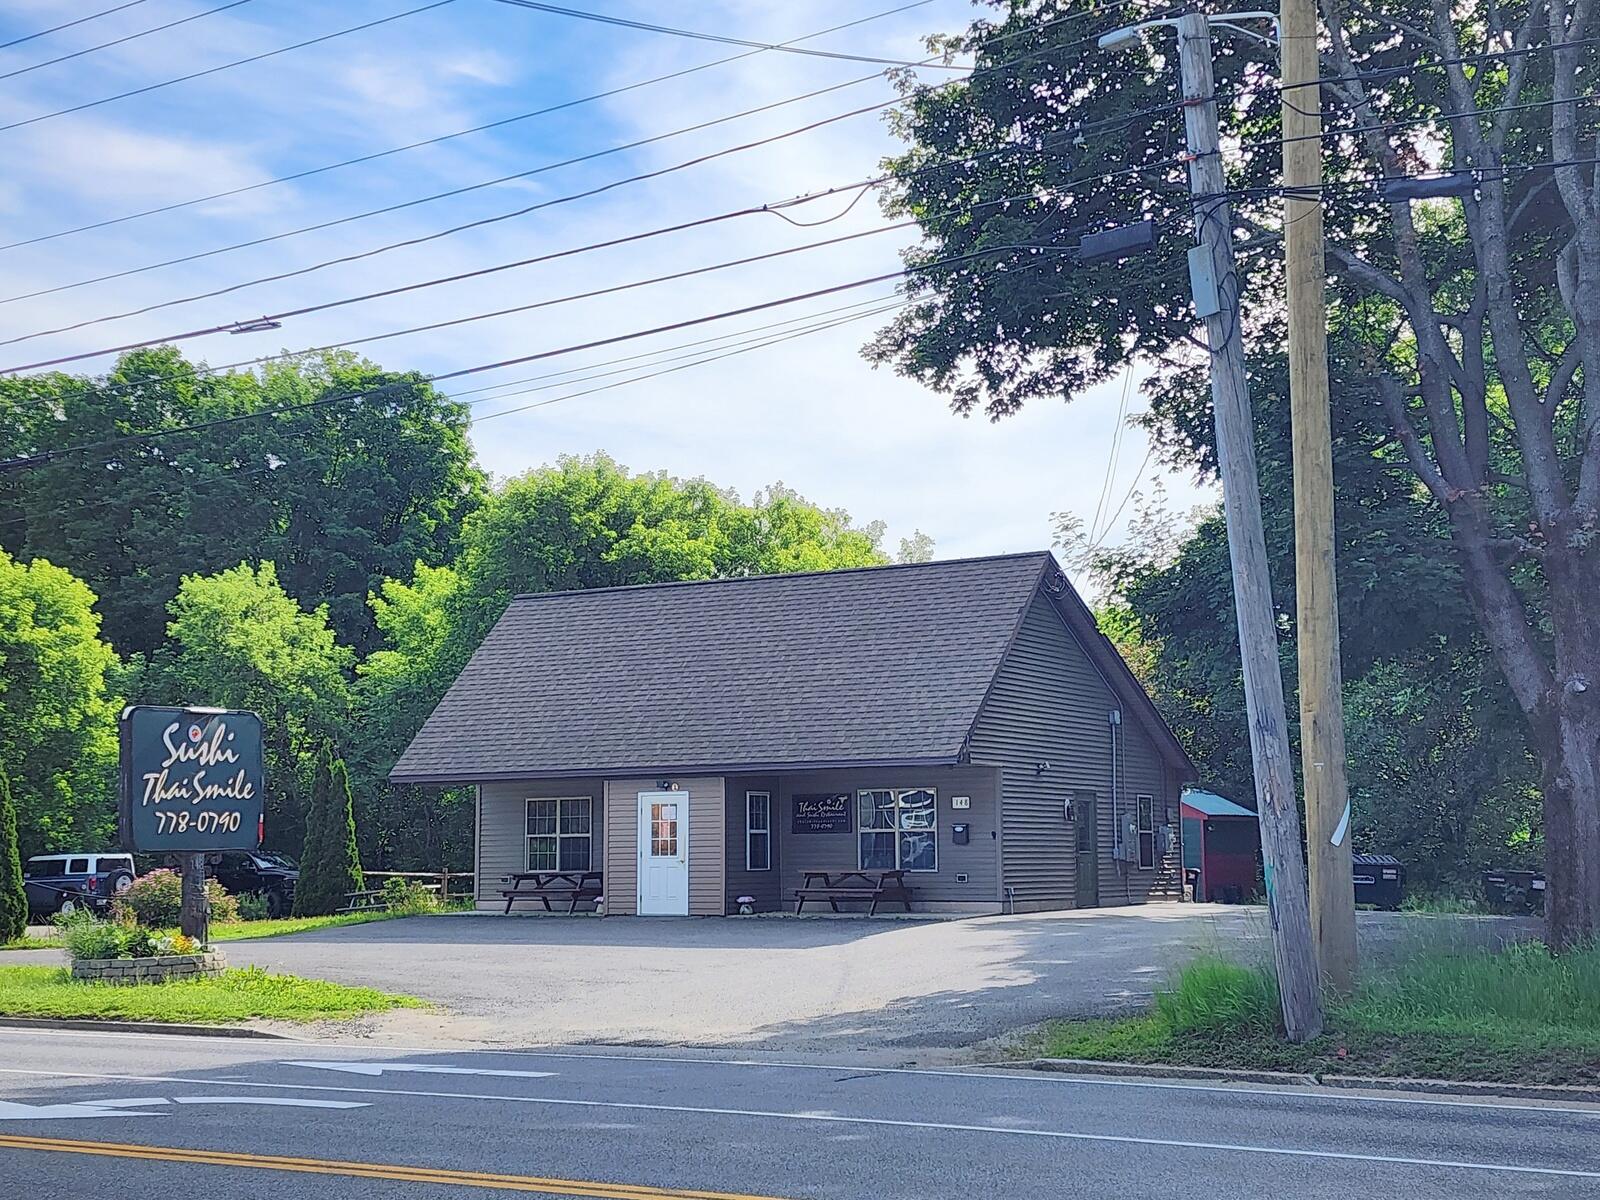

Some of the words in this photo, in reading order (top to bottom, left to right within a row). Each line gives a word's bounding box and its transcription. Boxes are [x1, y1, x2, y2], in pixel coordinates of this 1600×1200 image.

[162, 722, 240, 768] Sushi
[142, 768, 192, 806] Thai
[192, 769, 256, 805] Smile
[798, 801, 818, 813] Thai
[818, 801, 845, 813] Smile
[155, 811, 241, 834] 778-0790
